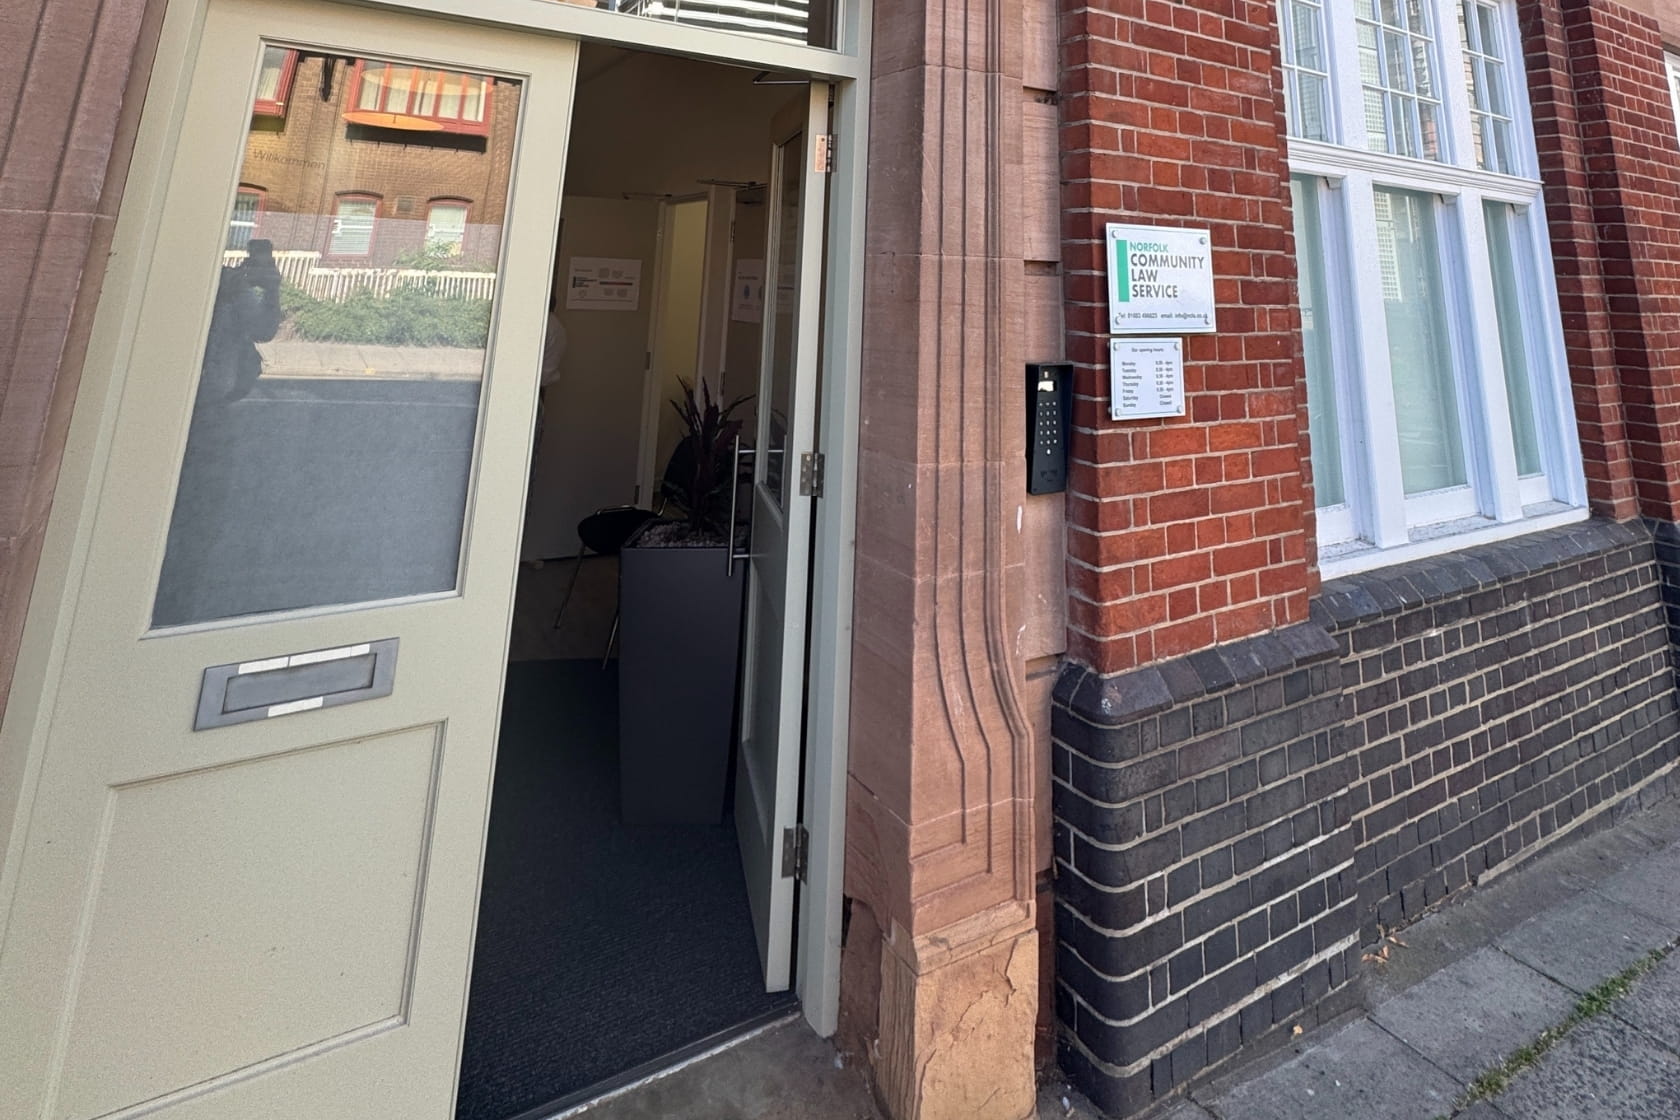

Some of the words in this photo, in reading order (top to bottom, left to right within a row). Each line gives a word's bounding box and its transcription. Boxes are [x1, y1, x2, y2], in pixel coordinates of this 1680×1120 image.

[1129, 242, 1169, 253] NORFOLK
[1130, 253, 1205, 269] COMMUNITY
[1131, 268, 1158, 282] LAW
[1132, 284, 1178, 298] SERVICE
